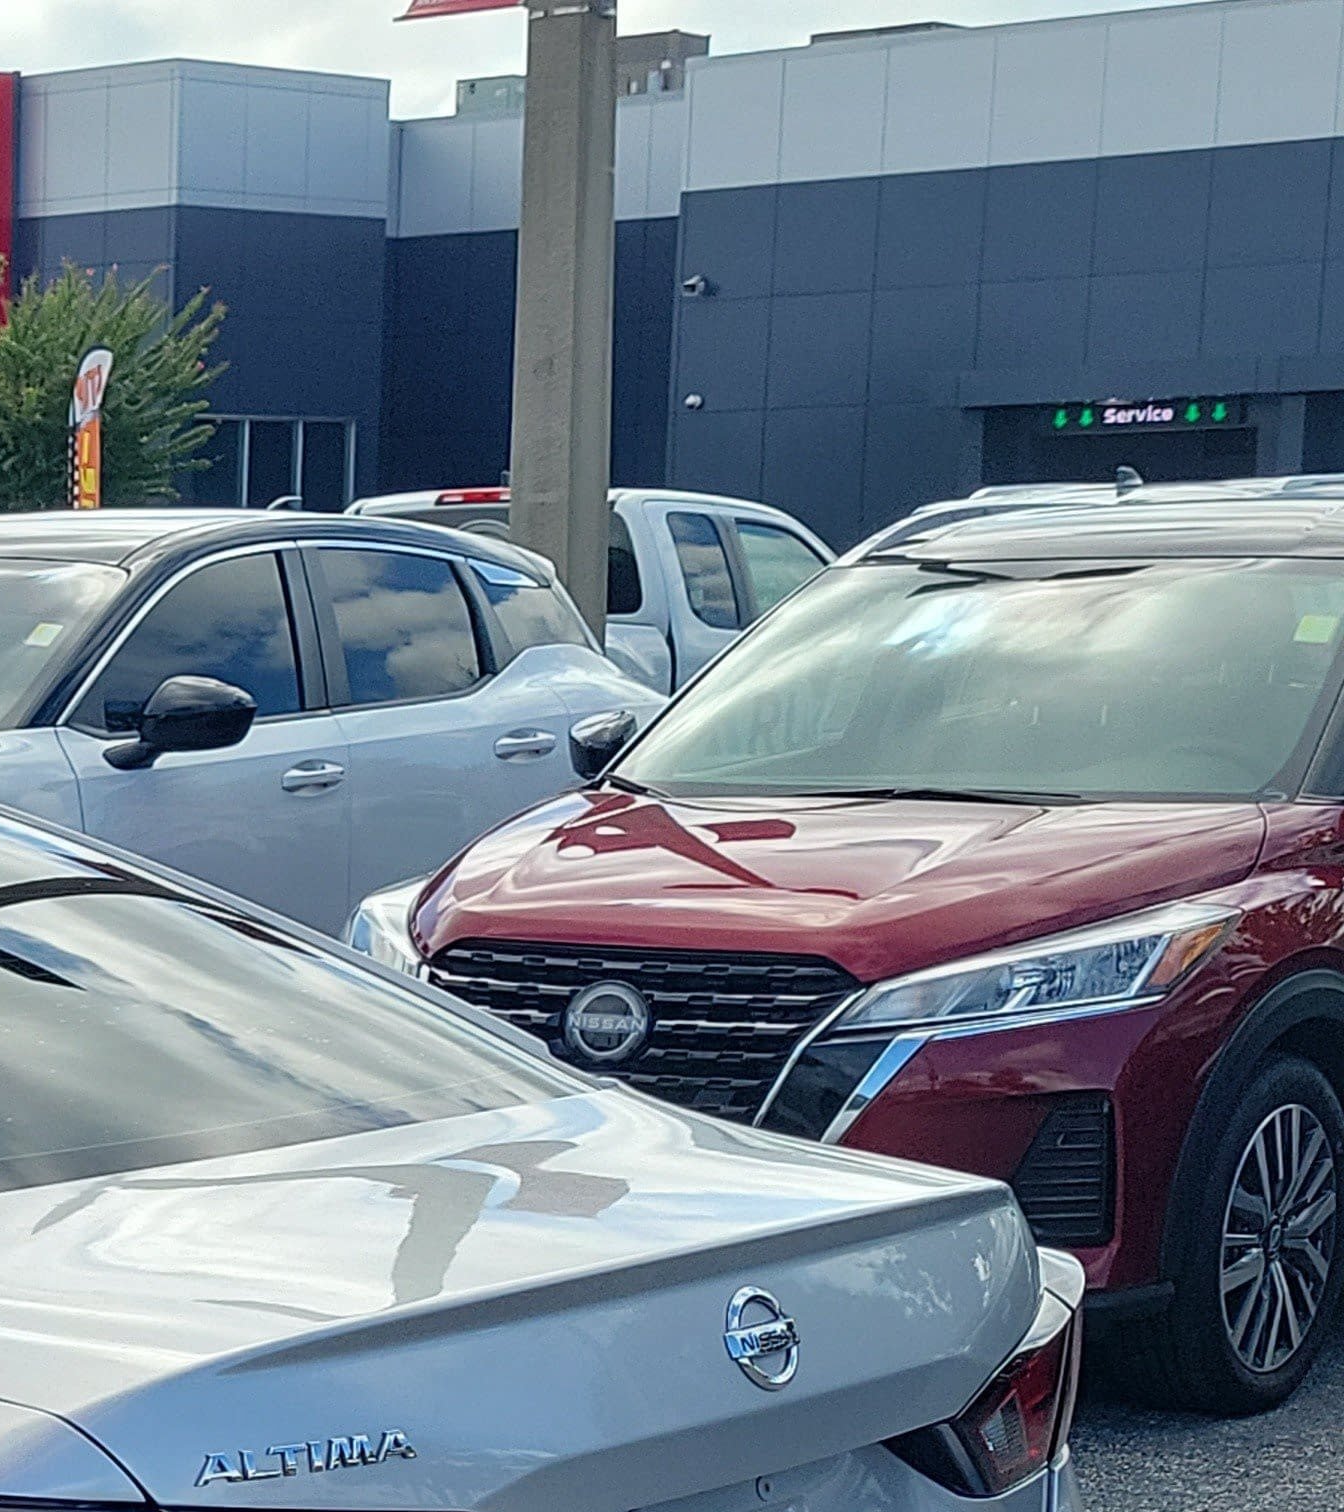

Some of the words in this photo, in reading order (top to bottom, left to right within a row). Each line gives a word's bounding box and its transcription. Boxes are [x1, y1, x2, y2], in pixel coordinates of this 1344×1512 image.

[1102, 405, 1174, 424] Service
[569, 1011, 646, 1034] NISSAN
[193, 1429, 417, 1488] ALTIMA
